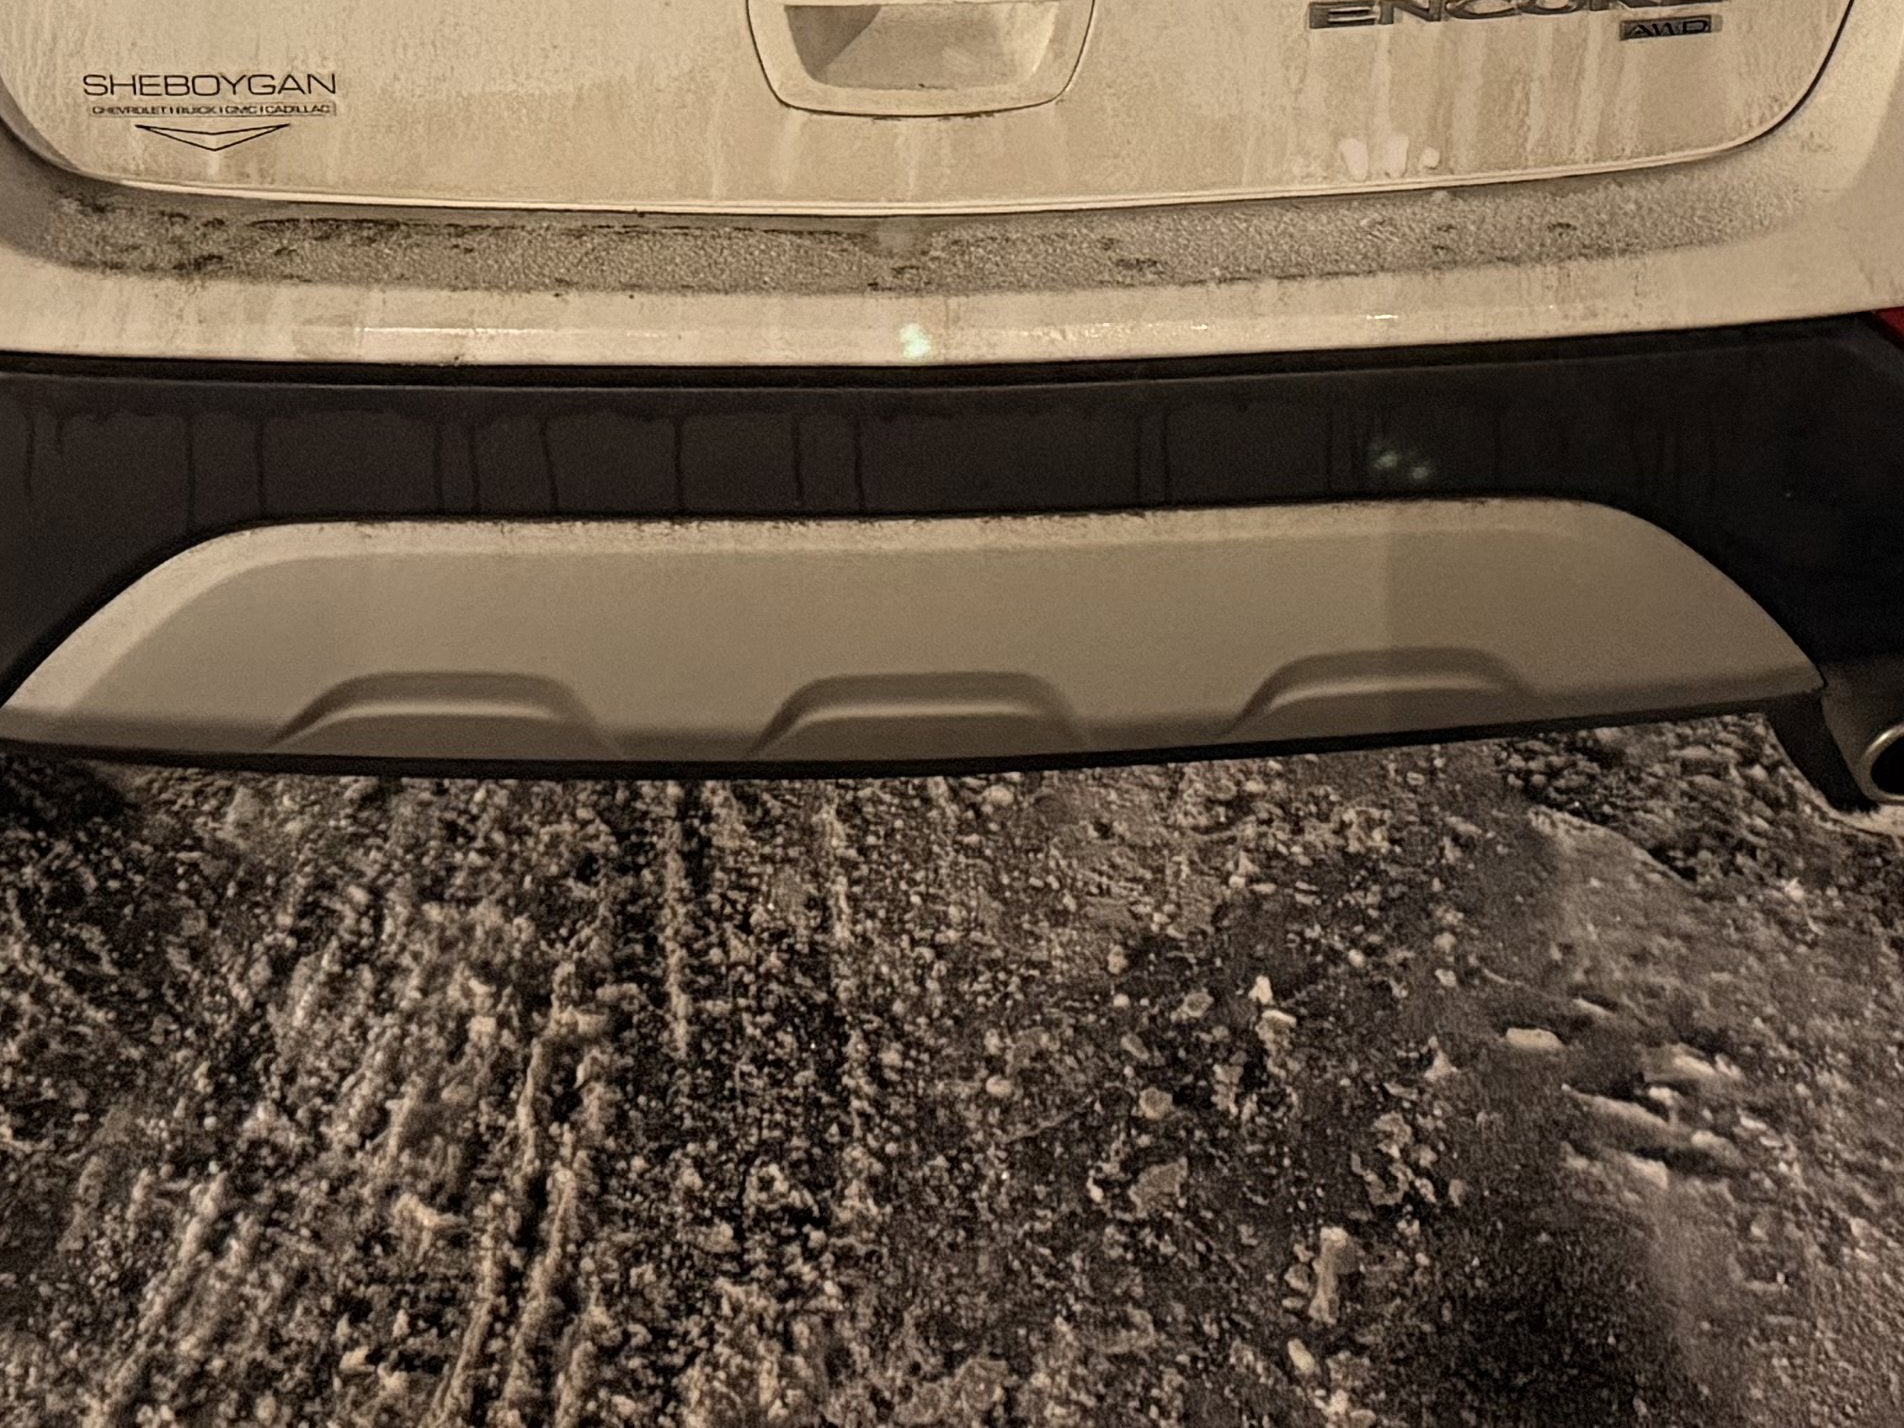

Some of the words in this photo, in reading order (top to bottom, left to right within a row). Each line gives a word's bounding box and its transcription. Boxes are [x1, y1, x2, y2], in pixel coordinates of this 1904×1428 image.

[1628, 19, 1710, 39] AWD
[82, 73, 336, 97] SHEBOYGAN
[265, 104, 331, 114] CADILLAC
